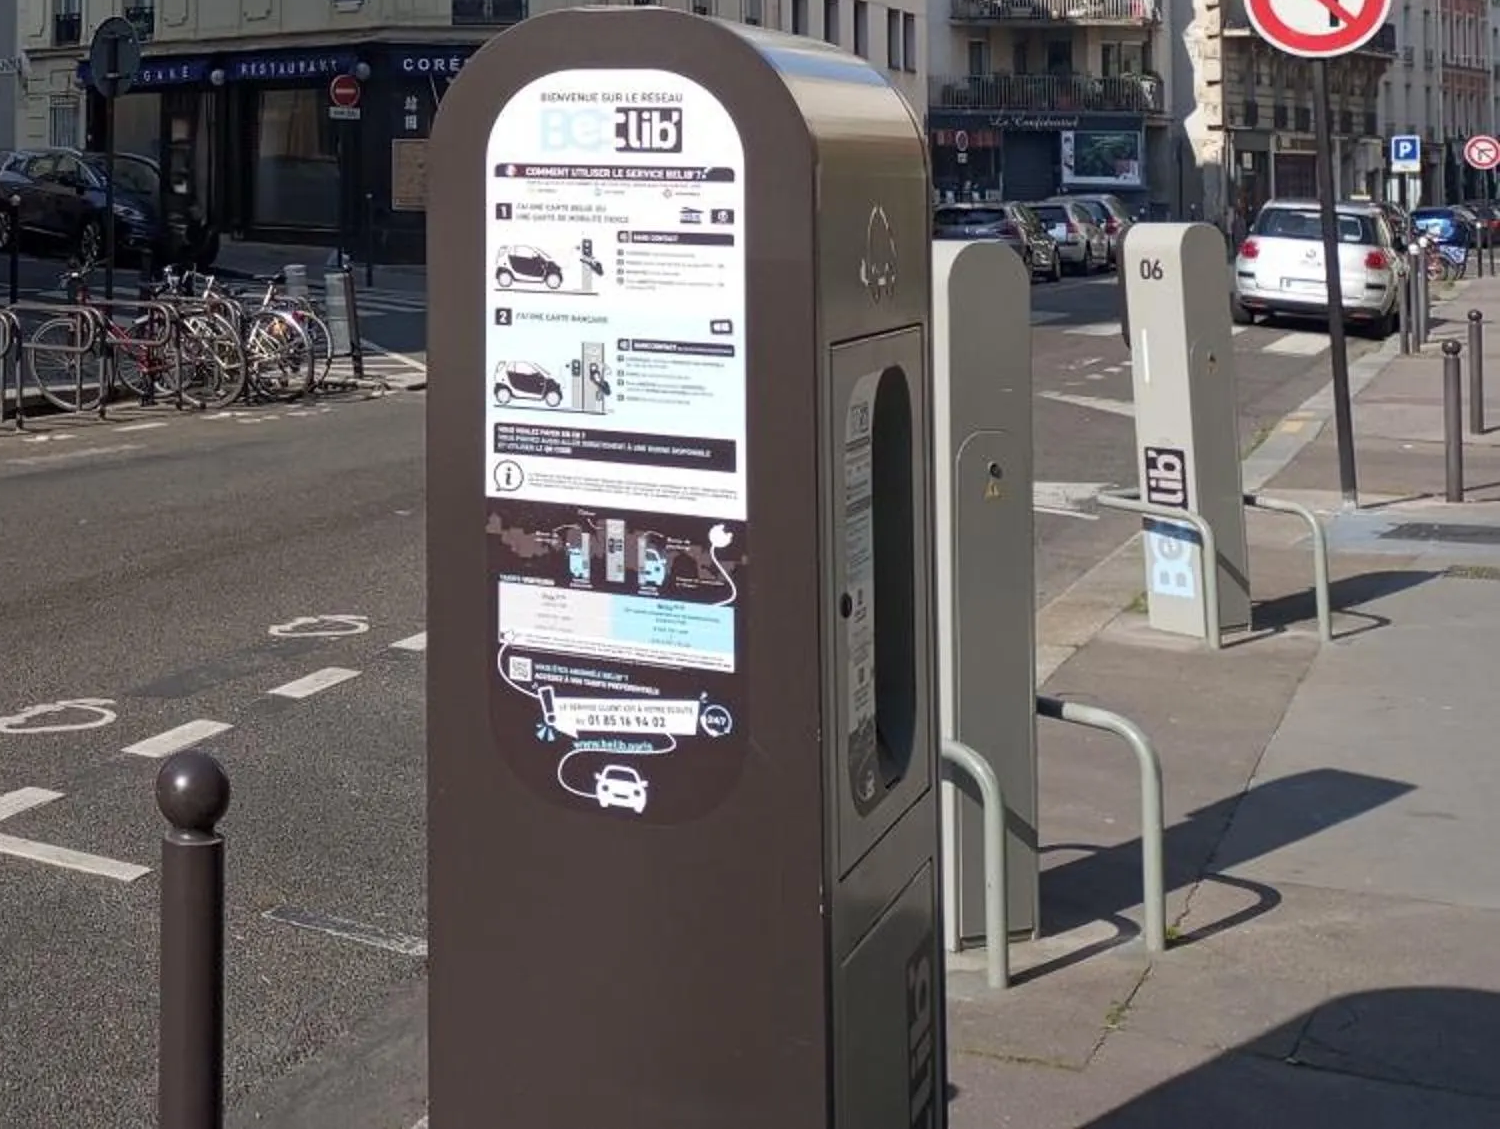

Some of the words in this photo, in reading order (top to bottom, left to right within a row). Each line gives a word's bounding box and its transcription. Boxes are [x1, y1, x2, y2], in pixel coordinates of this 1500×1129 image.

[241, 58, 339, 77] RESTAURANT
[541, 92, 598, 103] BIENVENUE
[601, 92, 622, 103] SUR
[625, 92, 638, 103] LE
[1399, 141, 1412, 158] P
[526, 167, 569, 177] COMMENT
[571, 168, 610, 178] UTILISER
[612, 169, 624, 178] LE
[626, 170, 664, 180] SERVICE
[1140, 259, 1163, 280] 06
[500, 310, 508, 324] 2
[588, 715, 600, 726] 01
[604, 716, 617, 727] 85
[620, 716, 632, 727] 16
[652, 718, 666, 729] 02
